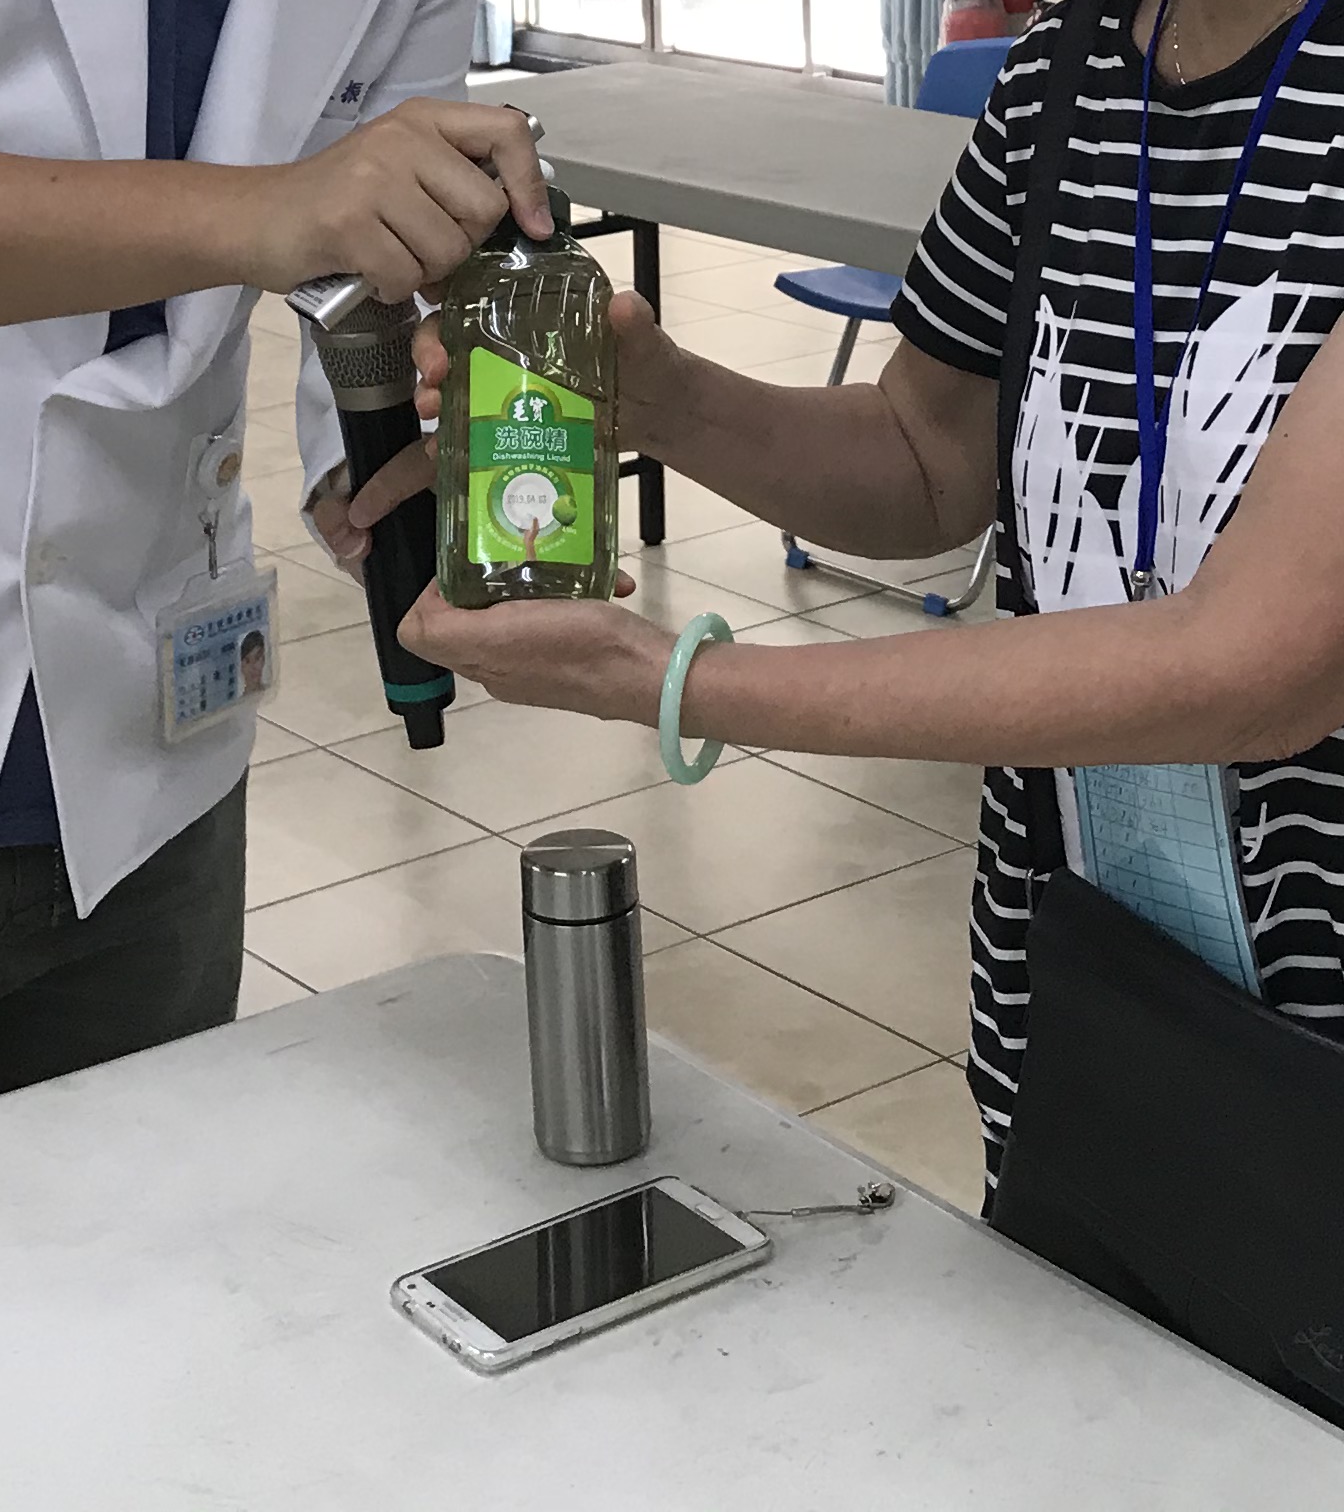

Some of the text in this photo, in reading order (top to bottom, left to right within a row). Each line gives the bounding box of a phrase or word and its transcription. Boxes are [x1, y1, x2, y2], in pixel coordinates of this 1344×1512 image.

[494, 425, 568, 452] 洗碗精
[492, 452, 545, 462] Dishwashing
